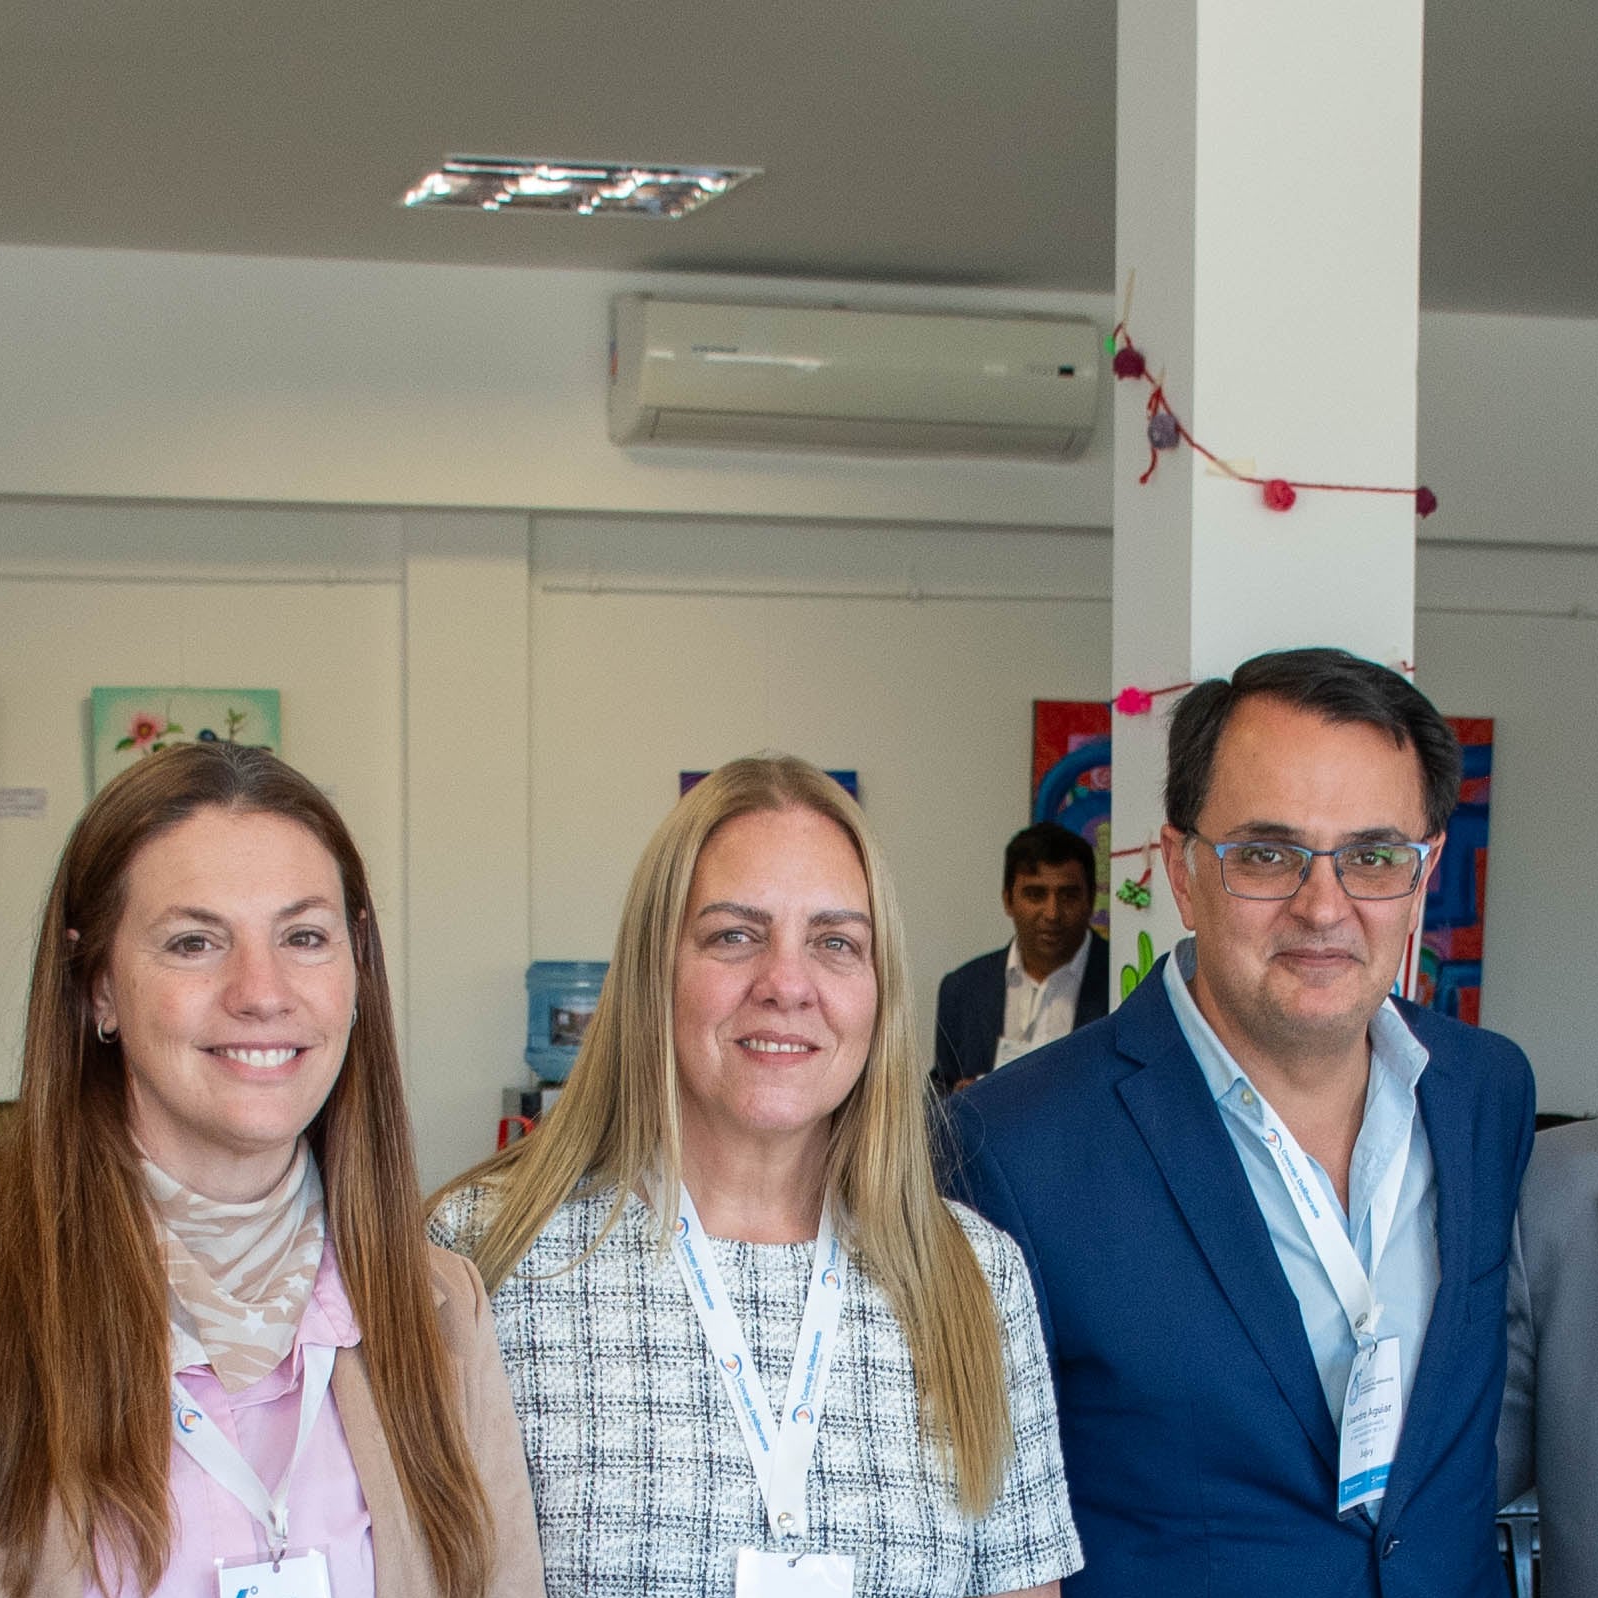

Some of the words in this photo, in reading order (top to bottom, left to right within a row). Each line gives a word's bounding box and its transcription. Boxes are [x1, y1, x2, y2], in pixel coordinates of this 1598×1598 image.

[683, 1239, 699, 1271] Concejo
[738, 1377, 753, 1409] Concejo
[801, 1371, 814, 1400] Concejo
